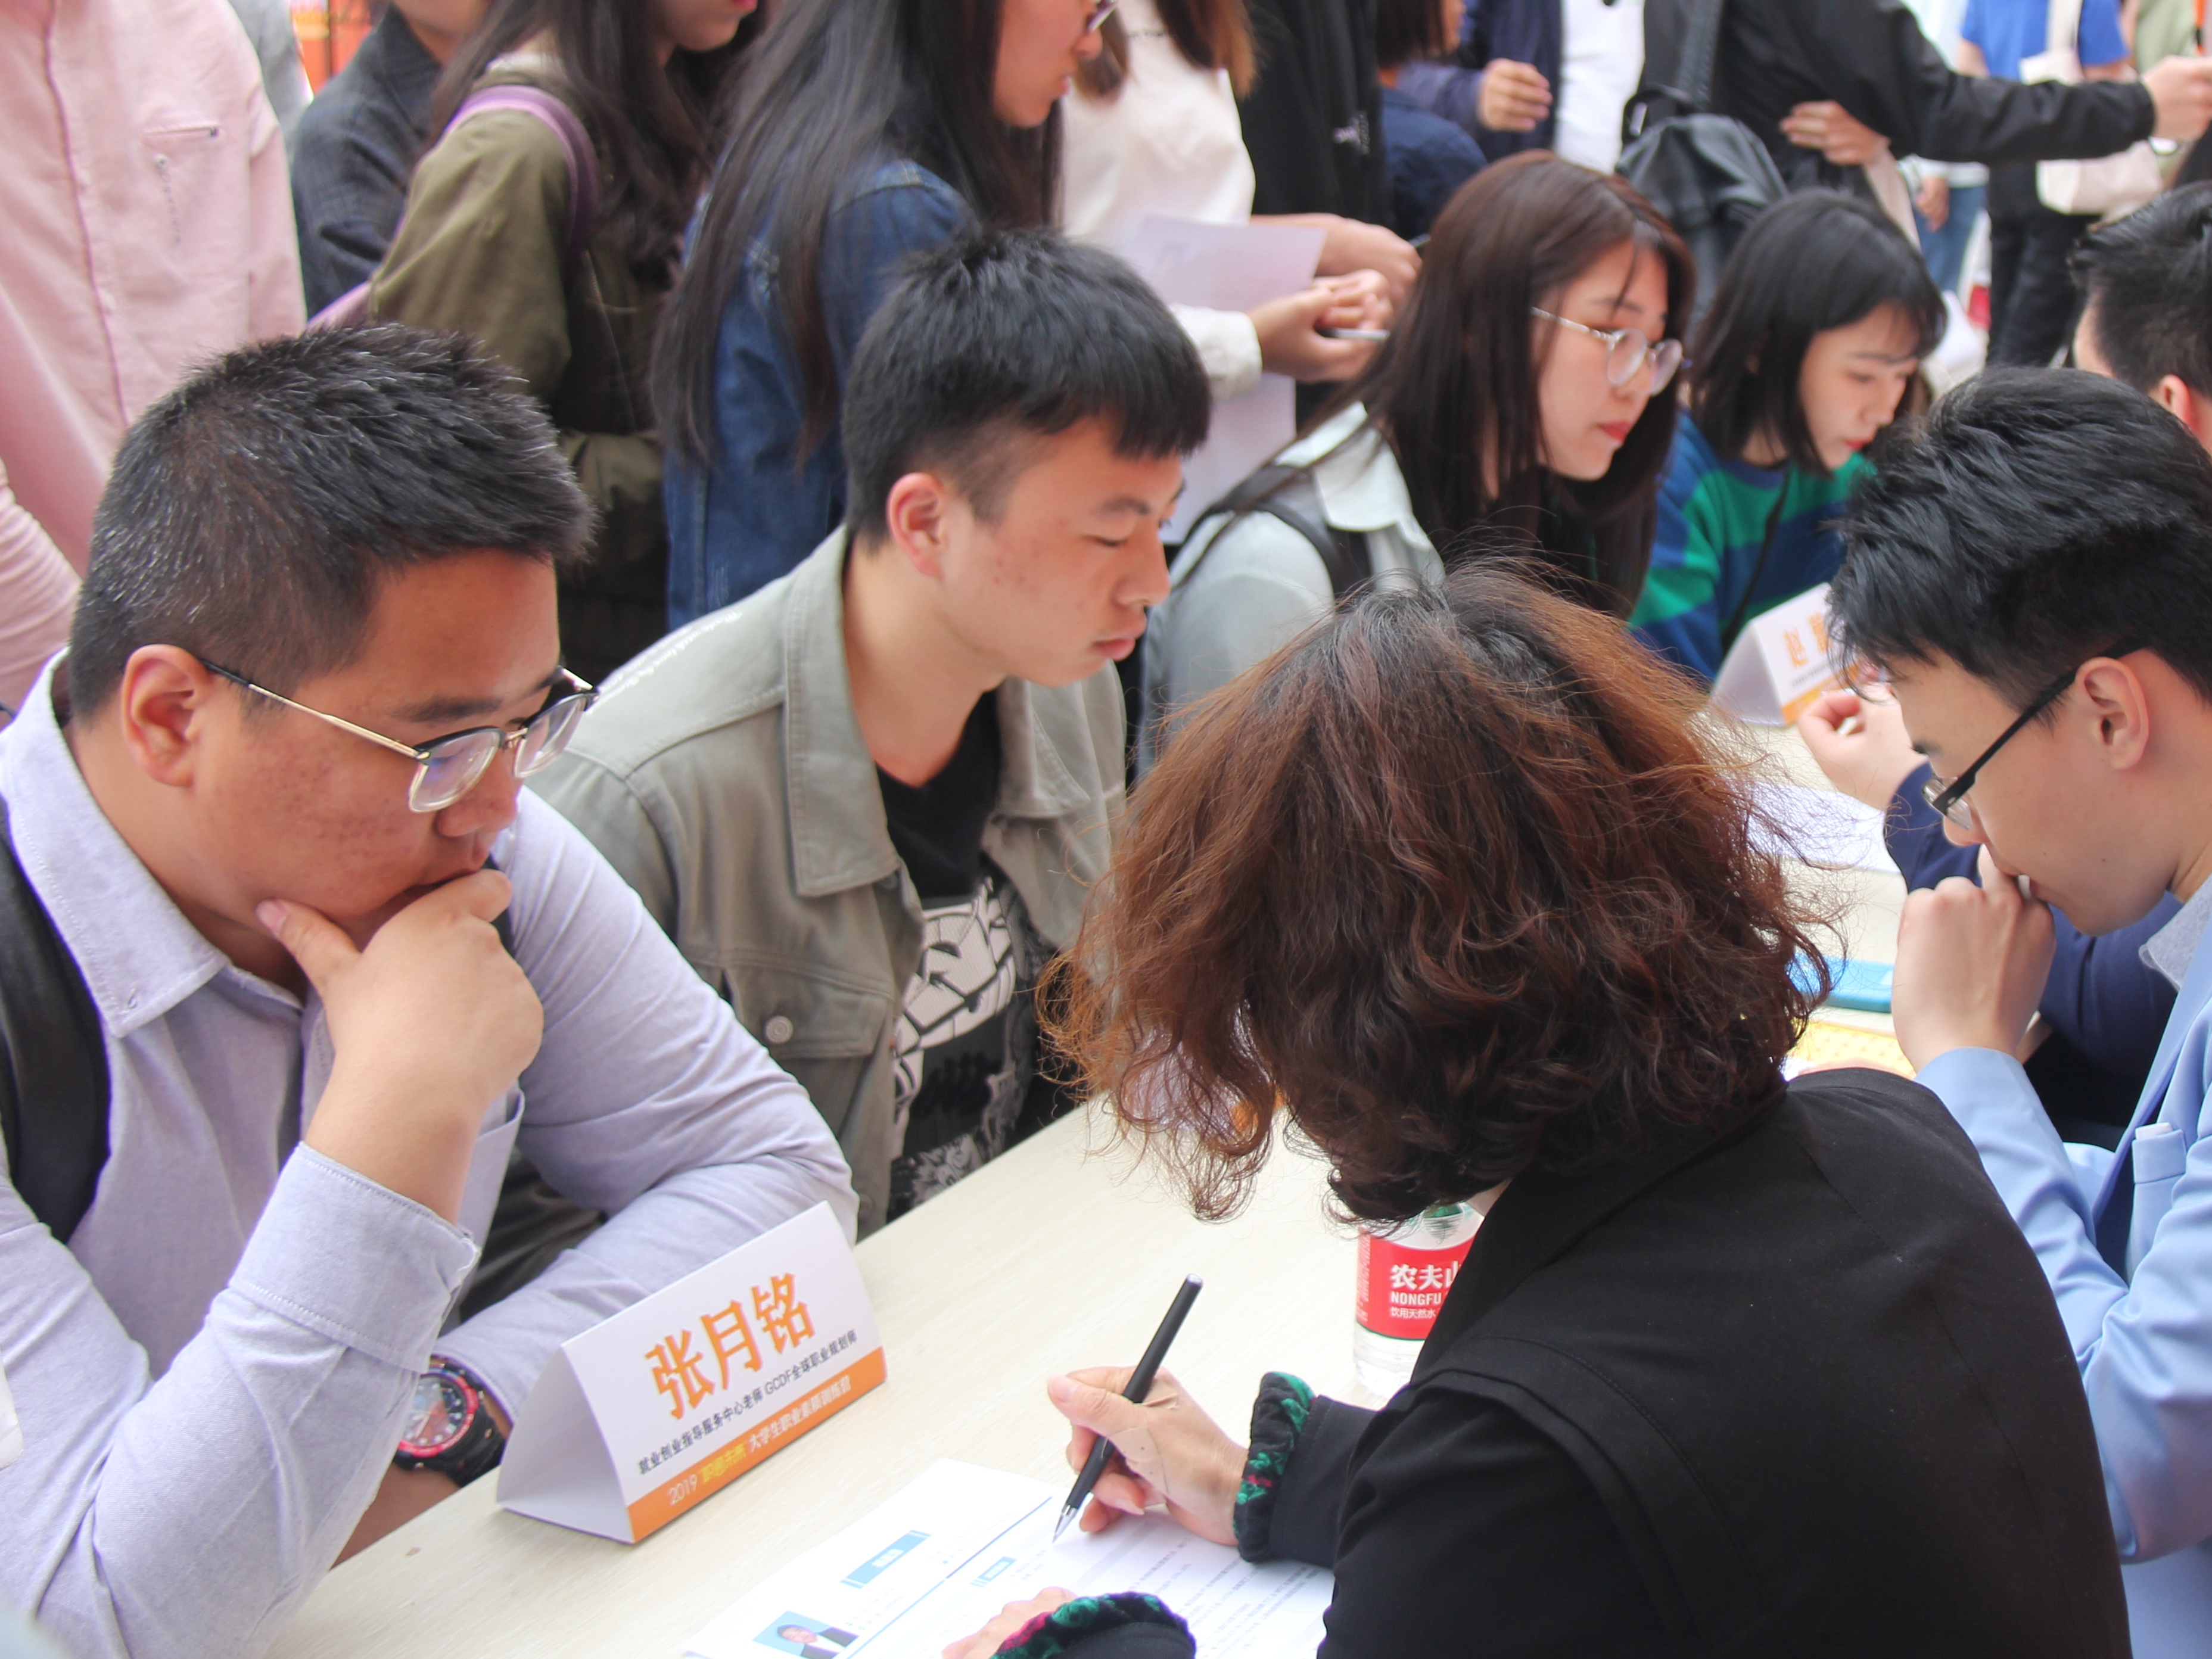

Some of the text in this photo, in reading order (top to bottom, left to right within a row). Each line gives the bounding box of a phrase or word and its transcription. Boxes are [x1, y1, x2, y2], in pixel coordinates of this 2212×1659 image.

[1390, 1291, 1442, 1305] NONGFU
[1390, 1306, 1436, 1319] 饮用天然水
[645, 1272, 816, 1420] 张月铭
[639, 1328, 858, 1475] 就业创业指导服务中心老师 GCDF全球职业规划师
[668, 1473, 698, 1506] 2019
